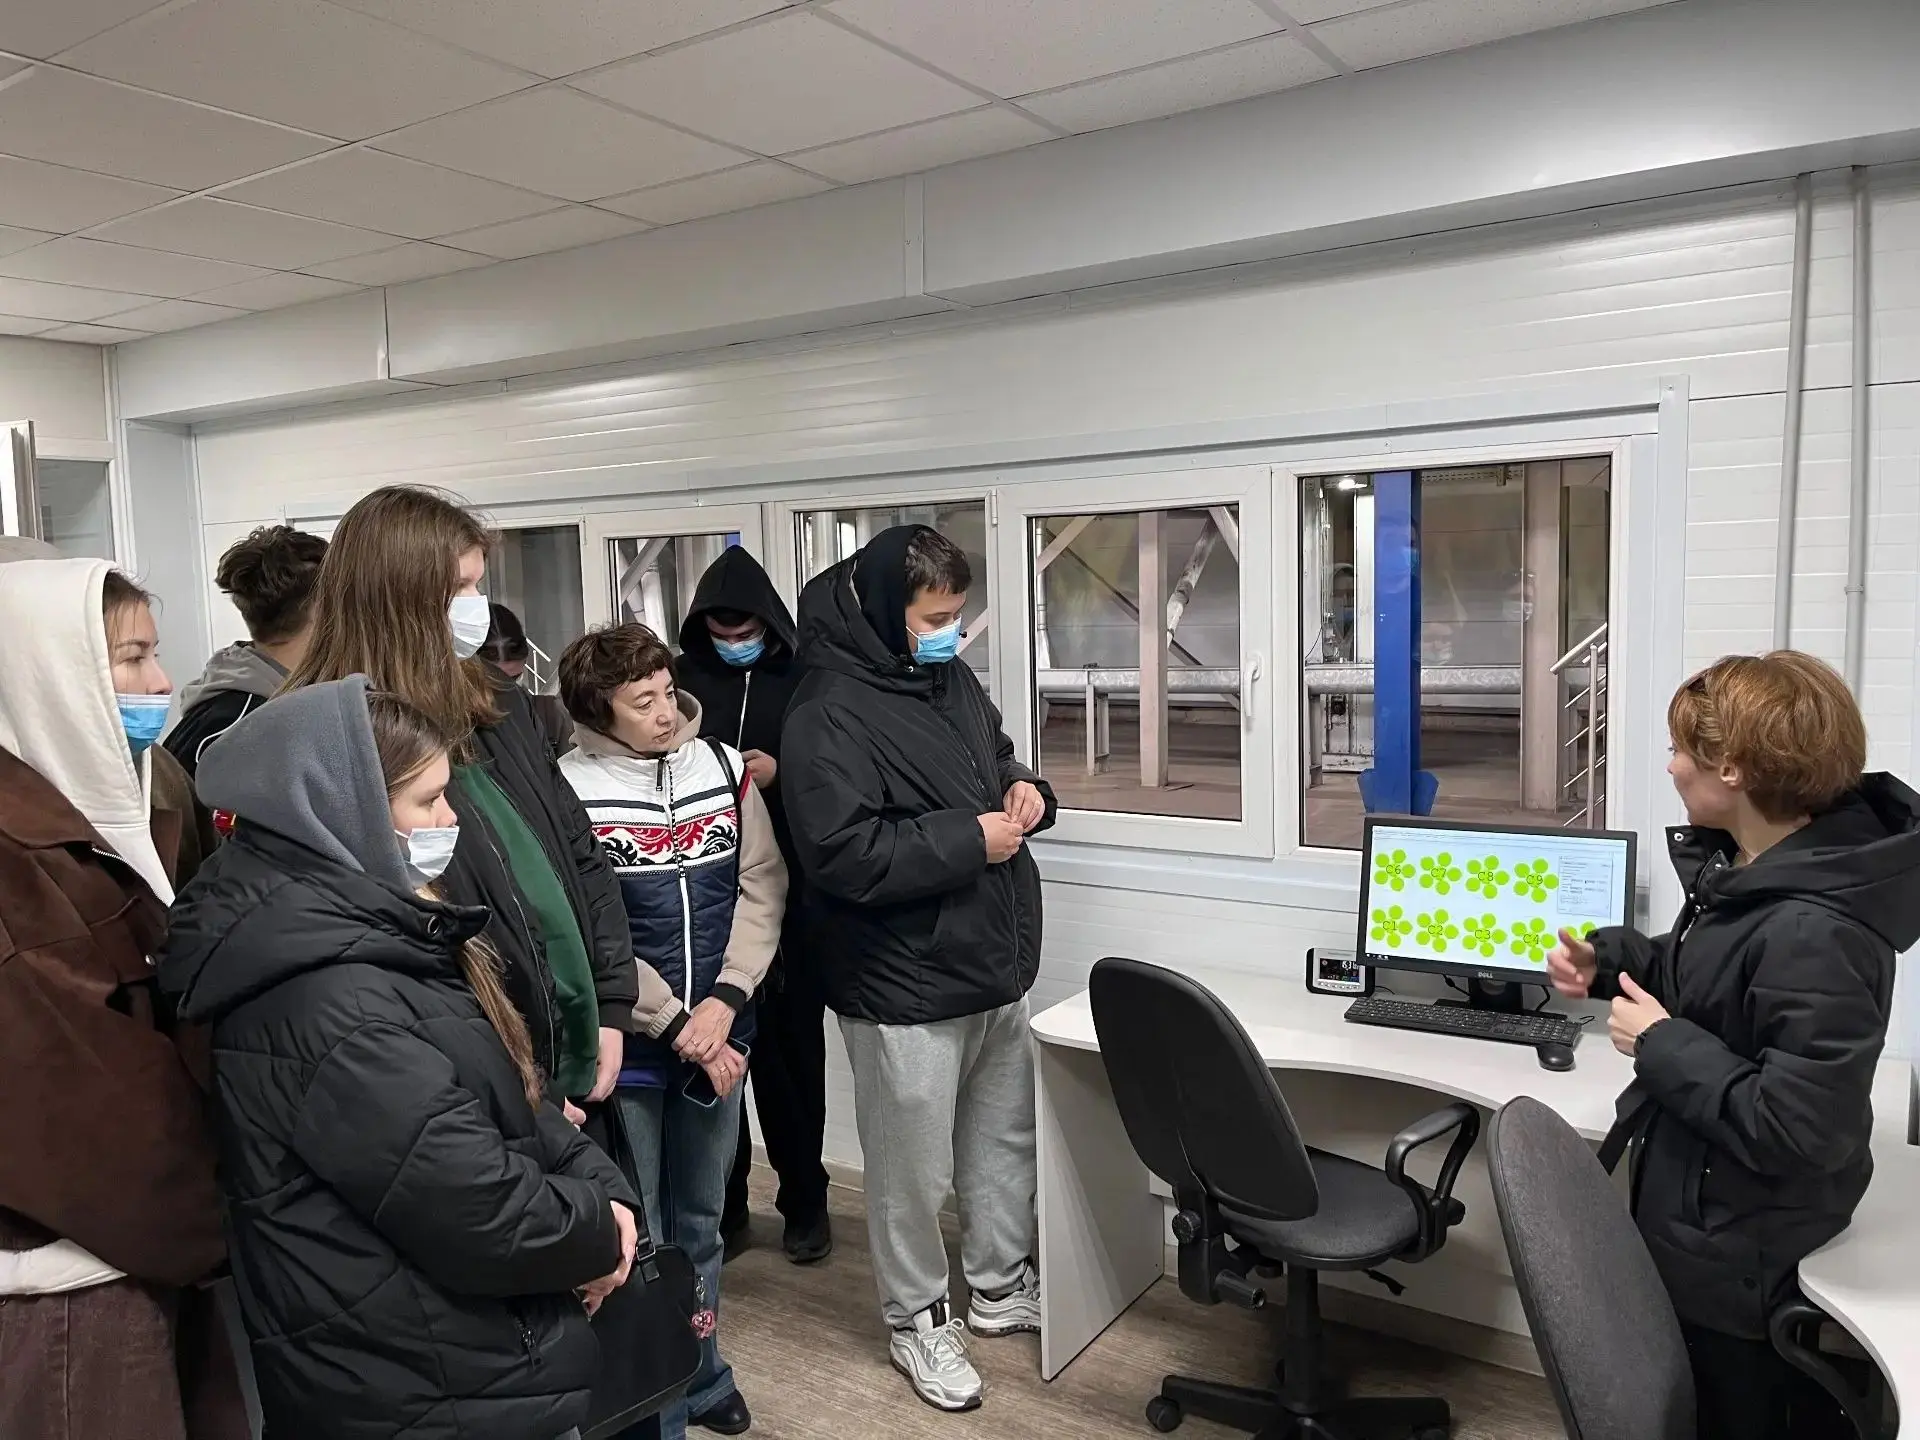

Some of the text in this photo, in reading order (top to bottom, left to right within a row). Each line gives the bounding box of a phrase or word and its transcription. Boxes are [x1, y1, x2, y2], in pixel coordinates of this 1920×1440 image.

[1385, 864, 1402, 875] C6
[1430, 867, 1447, 879] C7
[1477, 871, 1494, 882] C8
[1525, 874, 1544, 886] C9
[1382, 920, 1398, 932] C1
[1427, 924, 1444, 936] C2
[1474, 929, 1491, 940] C3
[1523, 933, 1540, 945] C4
[1477, 971, 1494, 979] DELL
